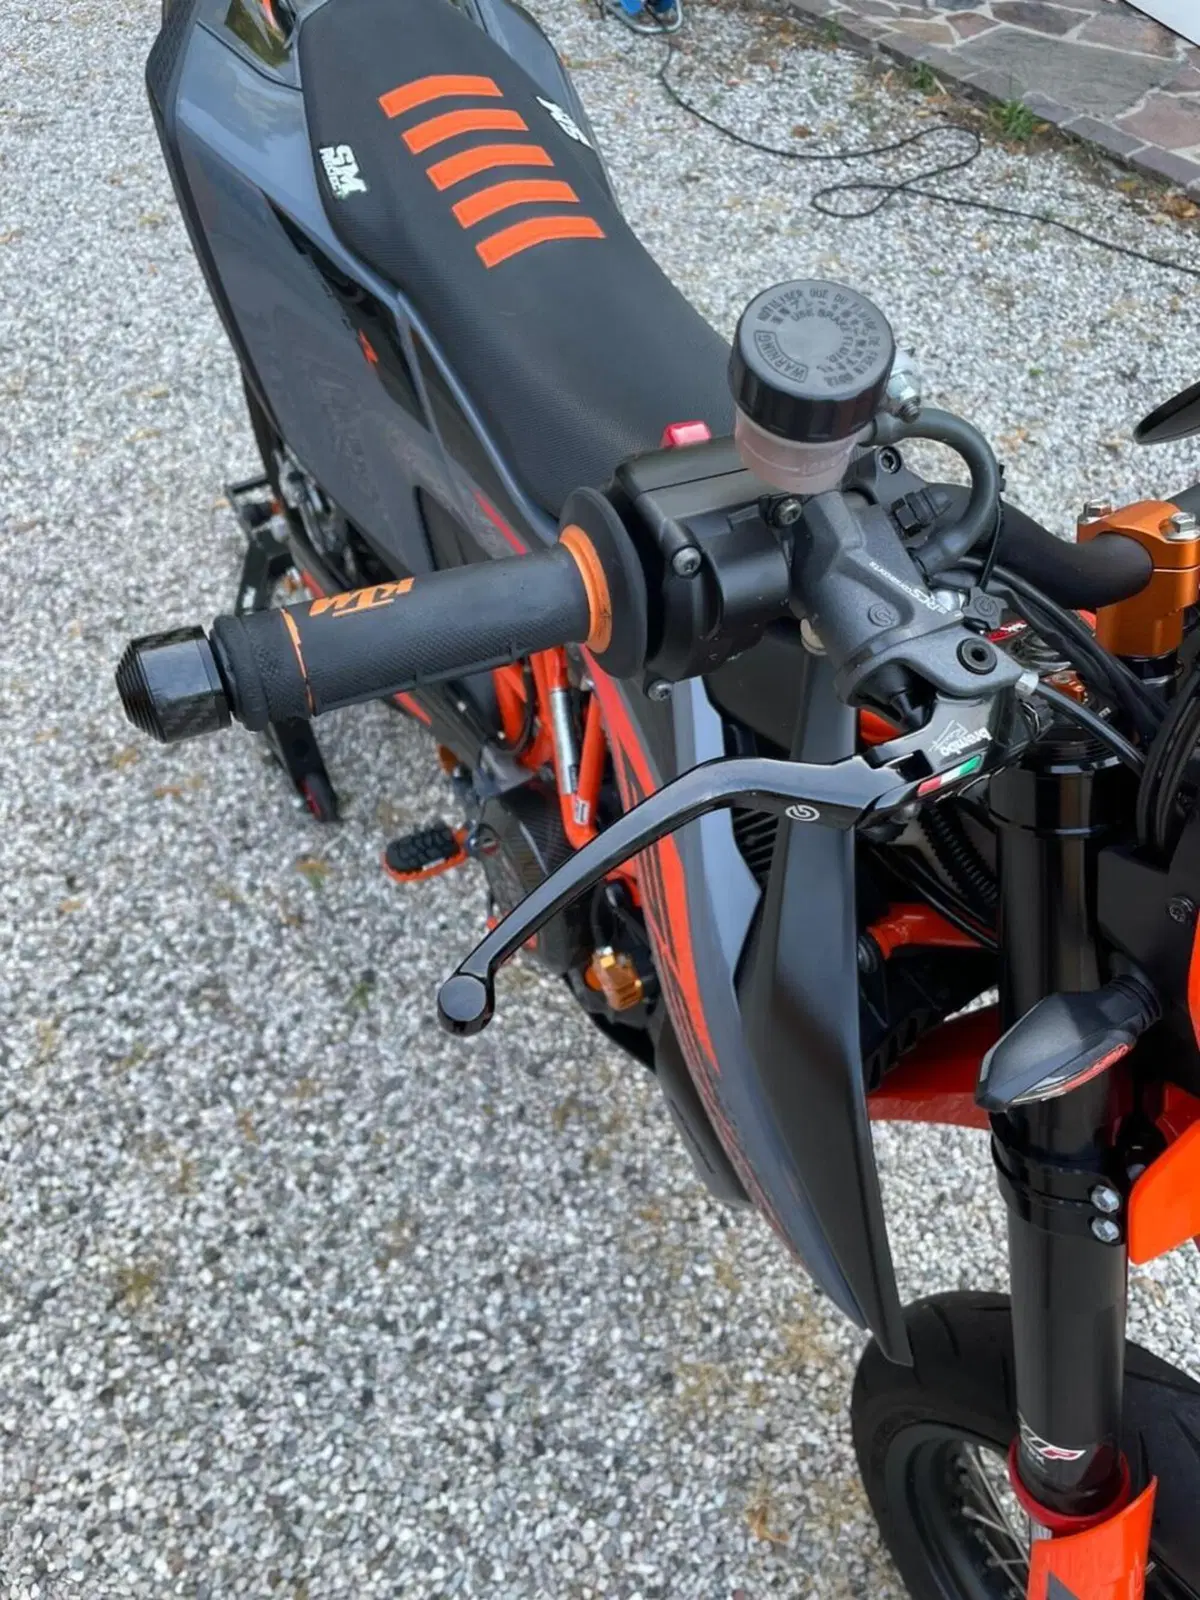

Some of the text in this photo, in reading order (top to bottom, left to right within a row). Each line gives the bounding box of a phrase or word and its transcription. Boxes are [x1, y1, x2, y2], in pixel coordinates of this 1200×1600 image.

[333, 144, 368, 195] SM
[758, 334, 806, 380] WARNING
[308, 576, 415, 618] KTM
[940, 727, 993, 757] brembo
